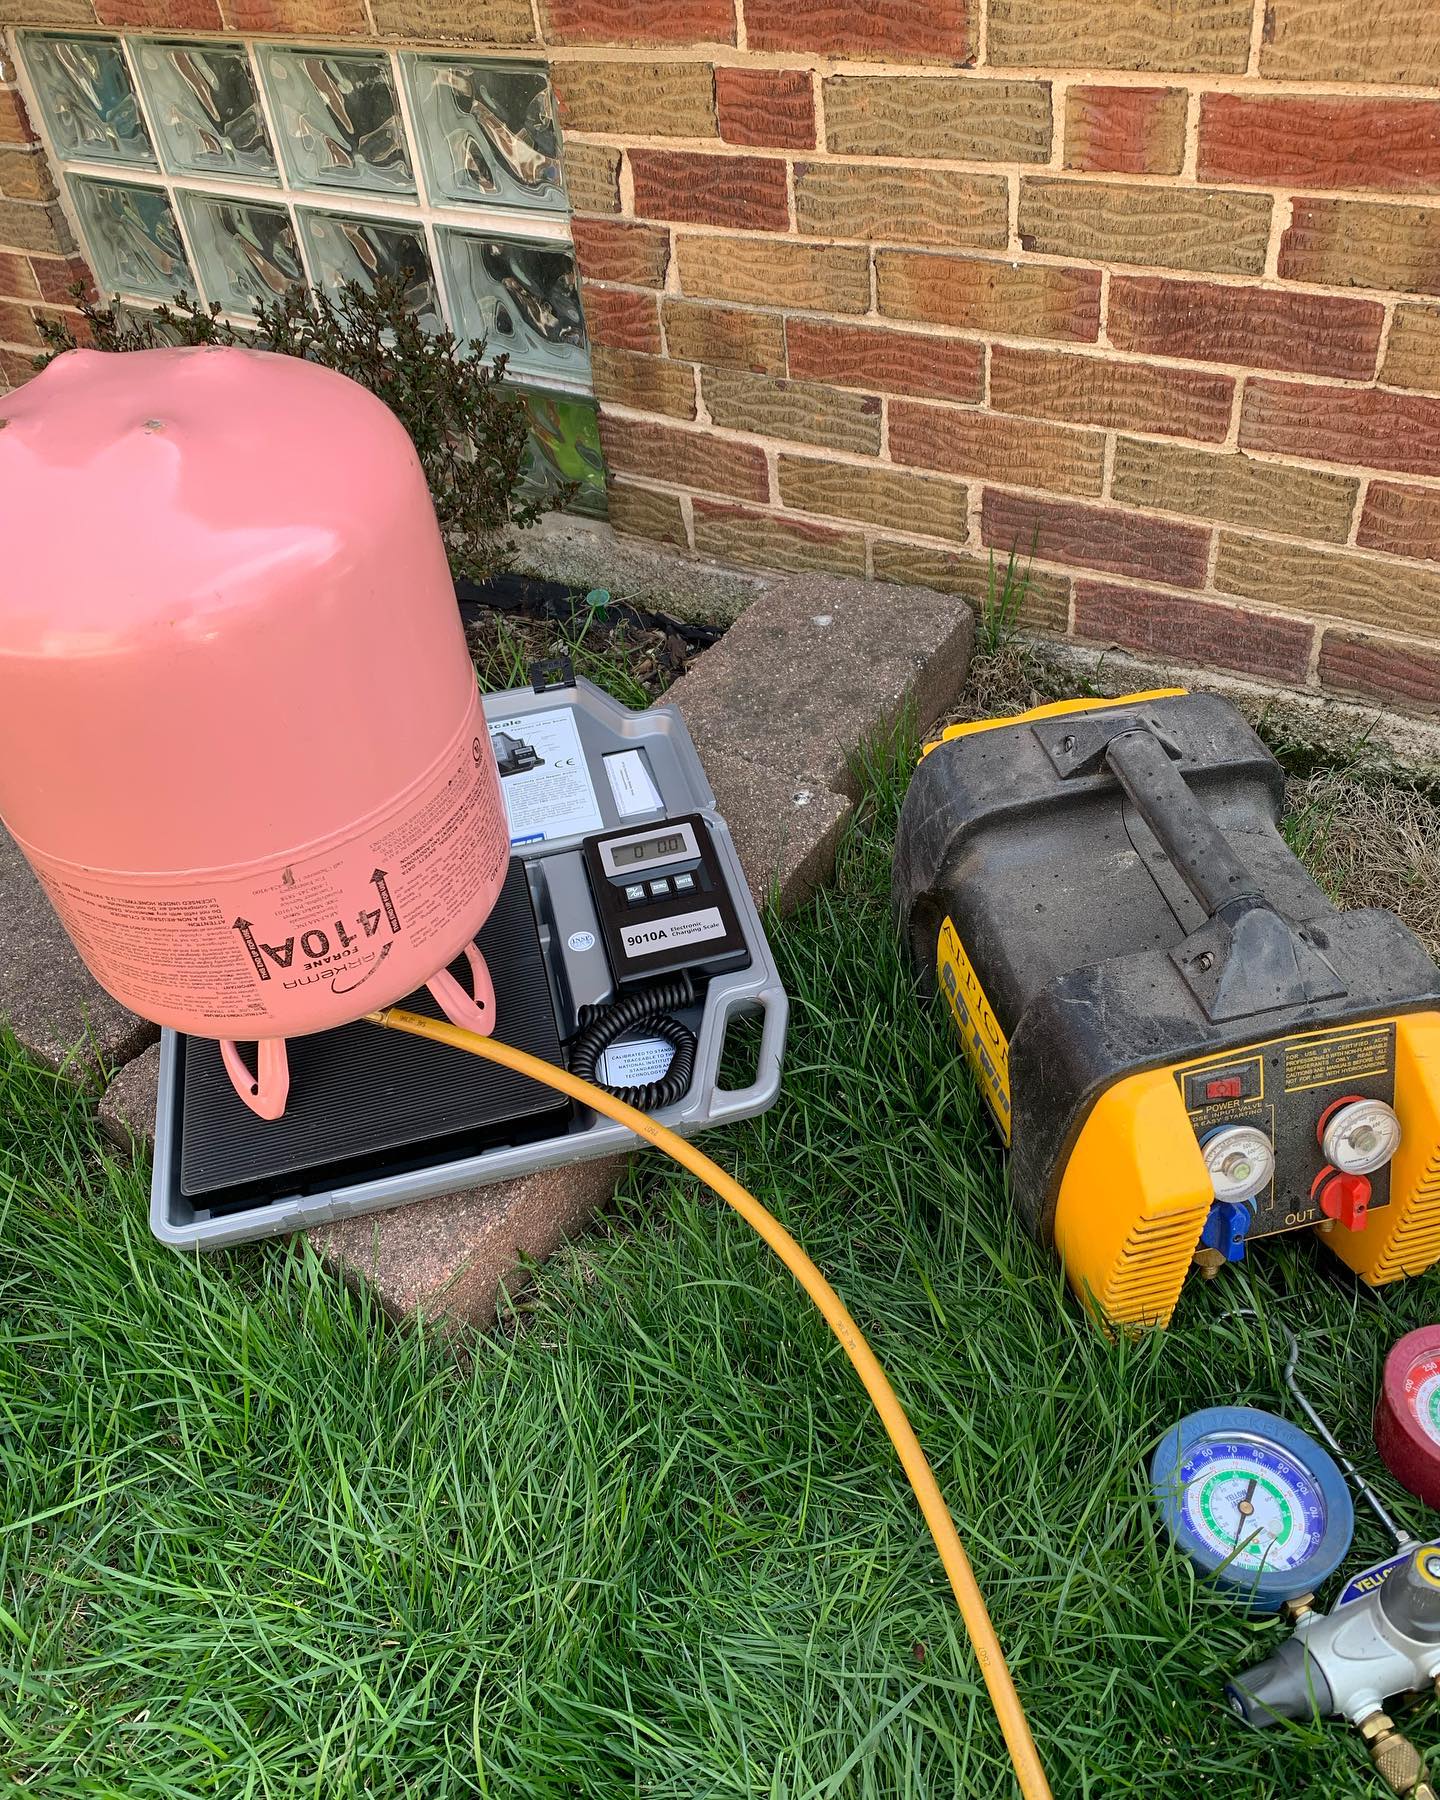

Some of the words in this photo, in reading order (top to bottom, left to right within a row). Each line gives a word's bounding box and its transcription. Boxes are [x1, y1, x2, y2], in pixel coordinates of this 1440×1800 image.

[488, 720, 522, 730] Scale
[429, 836, 440, 847] AND
[398, 836, 434, 864] INFORMATION
[417, 847, 436, 864] SAFETY
[399, 845, 431, 870] ADDITIONAL
[400, 863, 416, 876] DATA
[377, 879, 385, 891] USE
[384, 900, 391, 909] UP
[670, 920, 702, 932] Electronic
[672, 927, 702, 937] Charging
[703, 922, 720, 931] Scale
[241, 928, 250, 939] USE
[259, 908, 382, 968] 410A
[627, 930, 668, 946] 9010A
[246, 938, 255, 950] FOR
[254, 957, 262, 967] END
[304, 946, 358, 970] FORANE
[1337, 1040, 1368, 1050] CERTIFIED
[612, 1052, 646, 1060] CALIBRATED
[1285, 1053, 1330, 1066] PROFESSIONALS
[1285, 1059, 1329, 1072] REFRIGERANTS
[1286, 1068, 1313, 1078] CAUTIONS
[1326, 1061, 1351, 1070] MANUALS
[1352, 1056, 1374, 1065] BEFORE
[1340, 1060, 1386, 1073] HYDROCARBONS
[1192, 1114, 1210, 1123] OSE
[1211, 1107, 1235, 1120] INPUT
[1238, 1102, 1262, 1114] VALVE
[1206, 1099, 1240, 1114] POWER
[1200, 1116, 1222, 1128] EASY
[1224, 1107, 1262, 1122] STARTING
[1285, 1208, 1316, 1225] OUT
[1423, 1362, 1438, 1372] 250
[1201, 1448, 1213, 1458] 60
[1252, 1450, 1264, 1459] 80
[1277, 1463, 1289, 1474] 90
[1296, 1481, 1309, 1496] 100
[1225, 1489, 1247, 1502] YELLOW
[1310, 1506, 1319, 1518] 110
[1312, 1532, 1320, 1544] 120
[1352, 1566, 1396, 1592] YELLO
